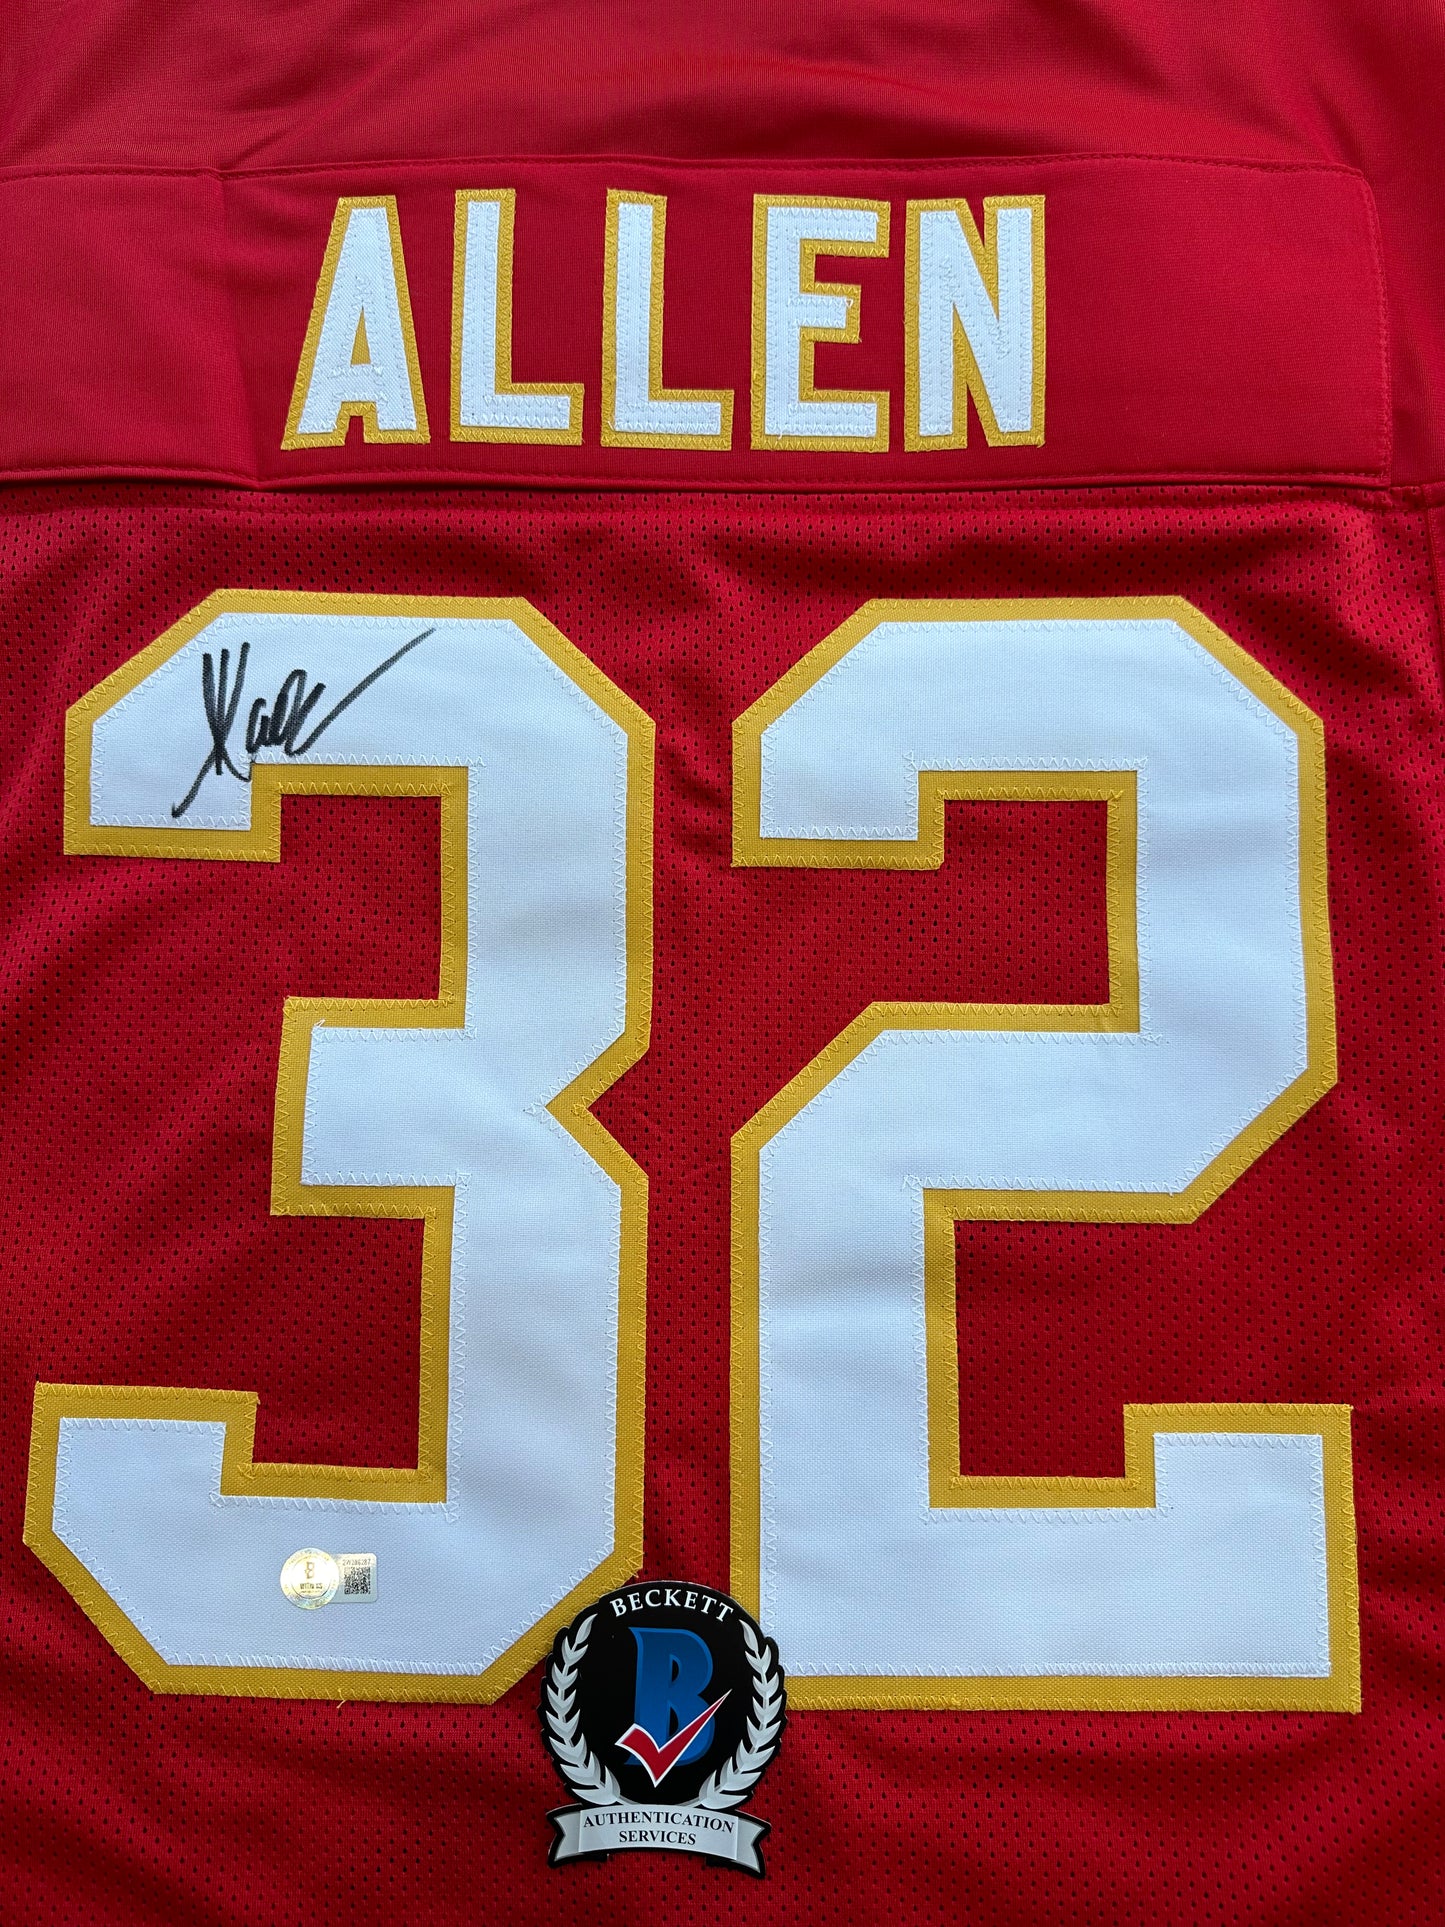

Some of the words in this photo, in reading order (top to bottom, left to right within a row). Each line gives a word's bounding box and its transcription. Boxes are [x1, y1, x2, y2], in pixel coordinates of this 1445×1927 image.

[281, 187, 1046, 453] ALLEN
[22, 586, 1363, 1714] 32
[609, 1587, 735, 1623] BECKETT
[583, 1810, 735, 1833] AUTHENTICATION
[619, 1829, 697, 1846] SERVICES
